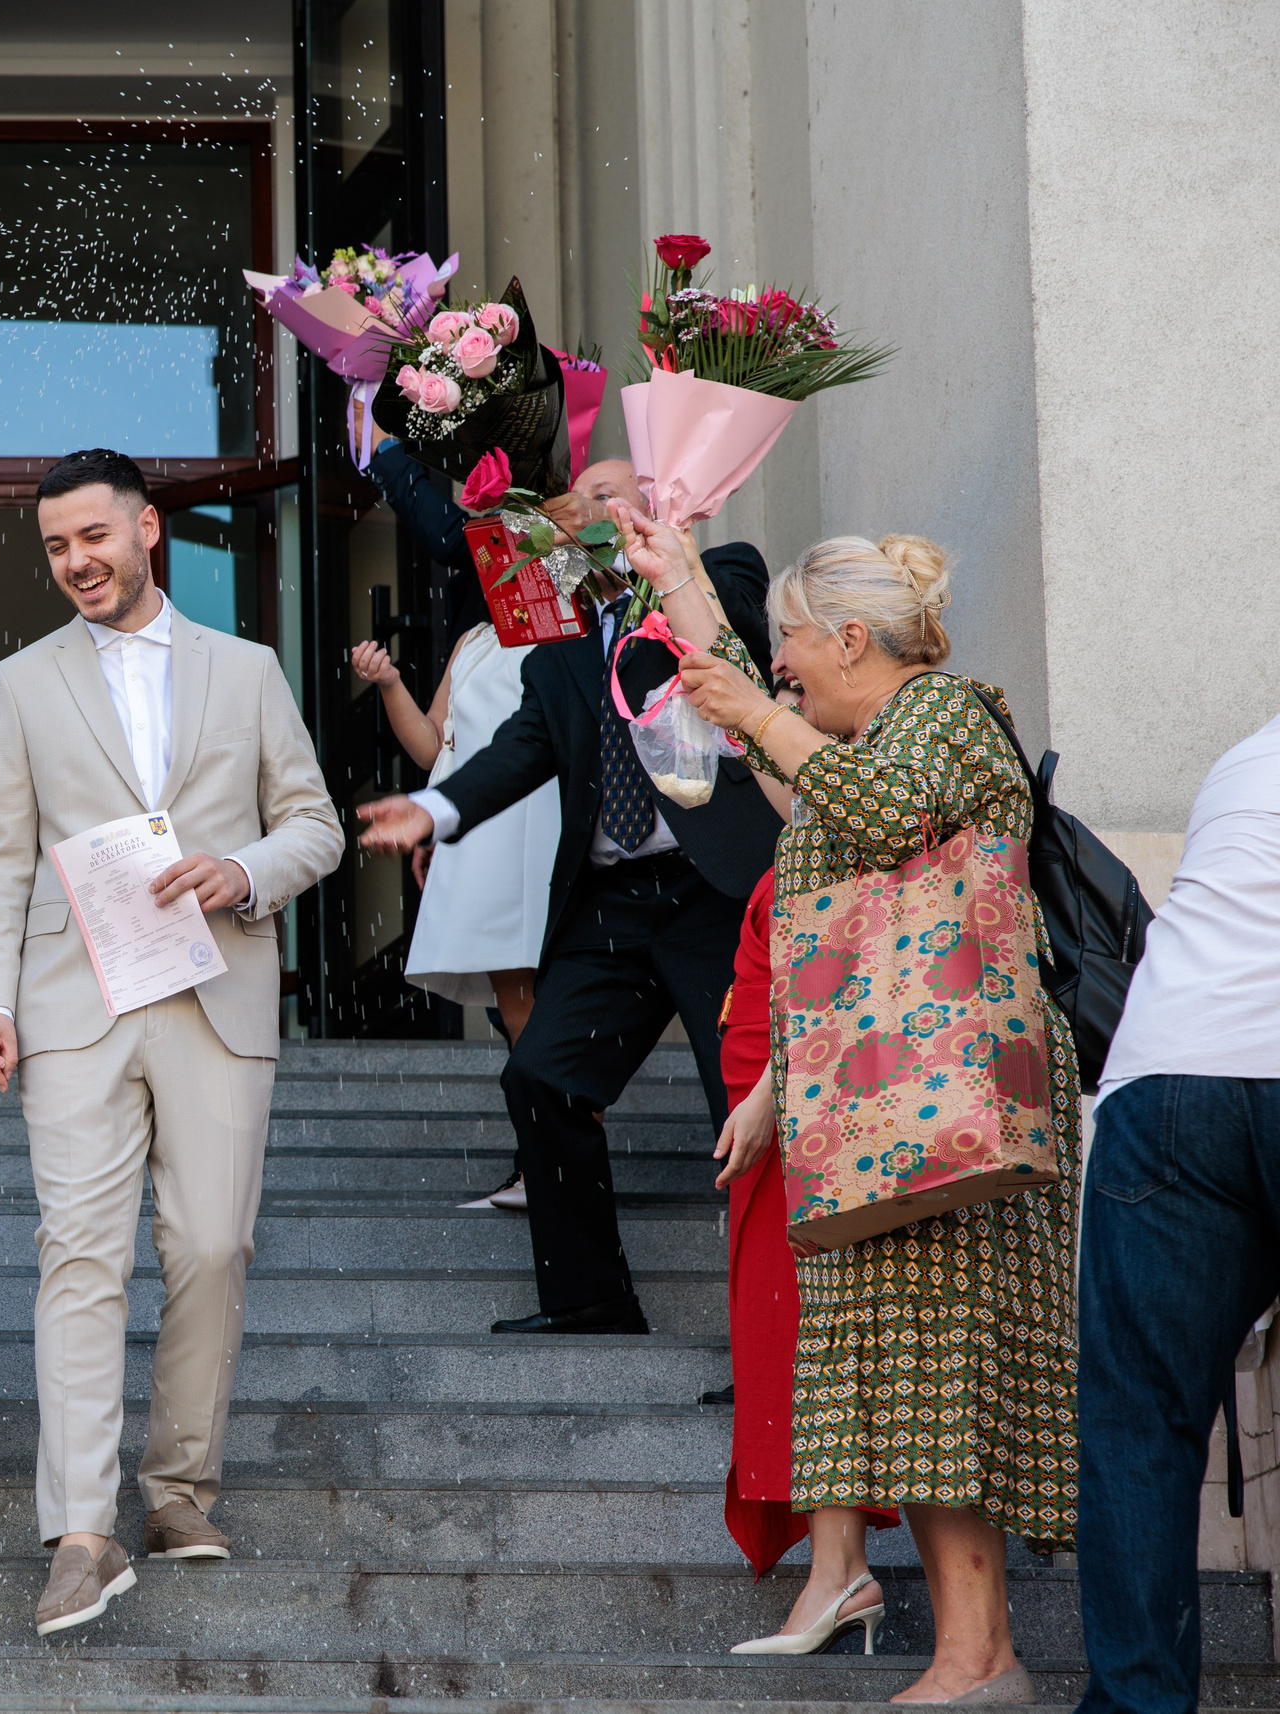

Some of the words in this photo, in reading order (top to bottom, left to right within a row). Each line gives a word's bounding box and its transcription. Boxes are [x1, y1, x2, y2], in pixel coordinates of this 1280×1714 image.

[493, 599, 508, 630] FERRERO
[501, 598, 514, 629] PRESTIGE
[91, 837, 140, 860] CERTIFICAT
[89, 860, 100, 868] DE
